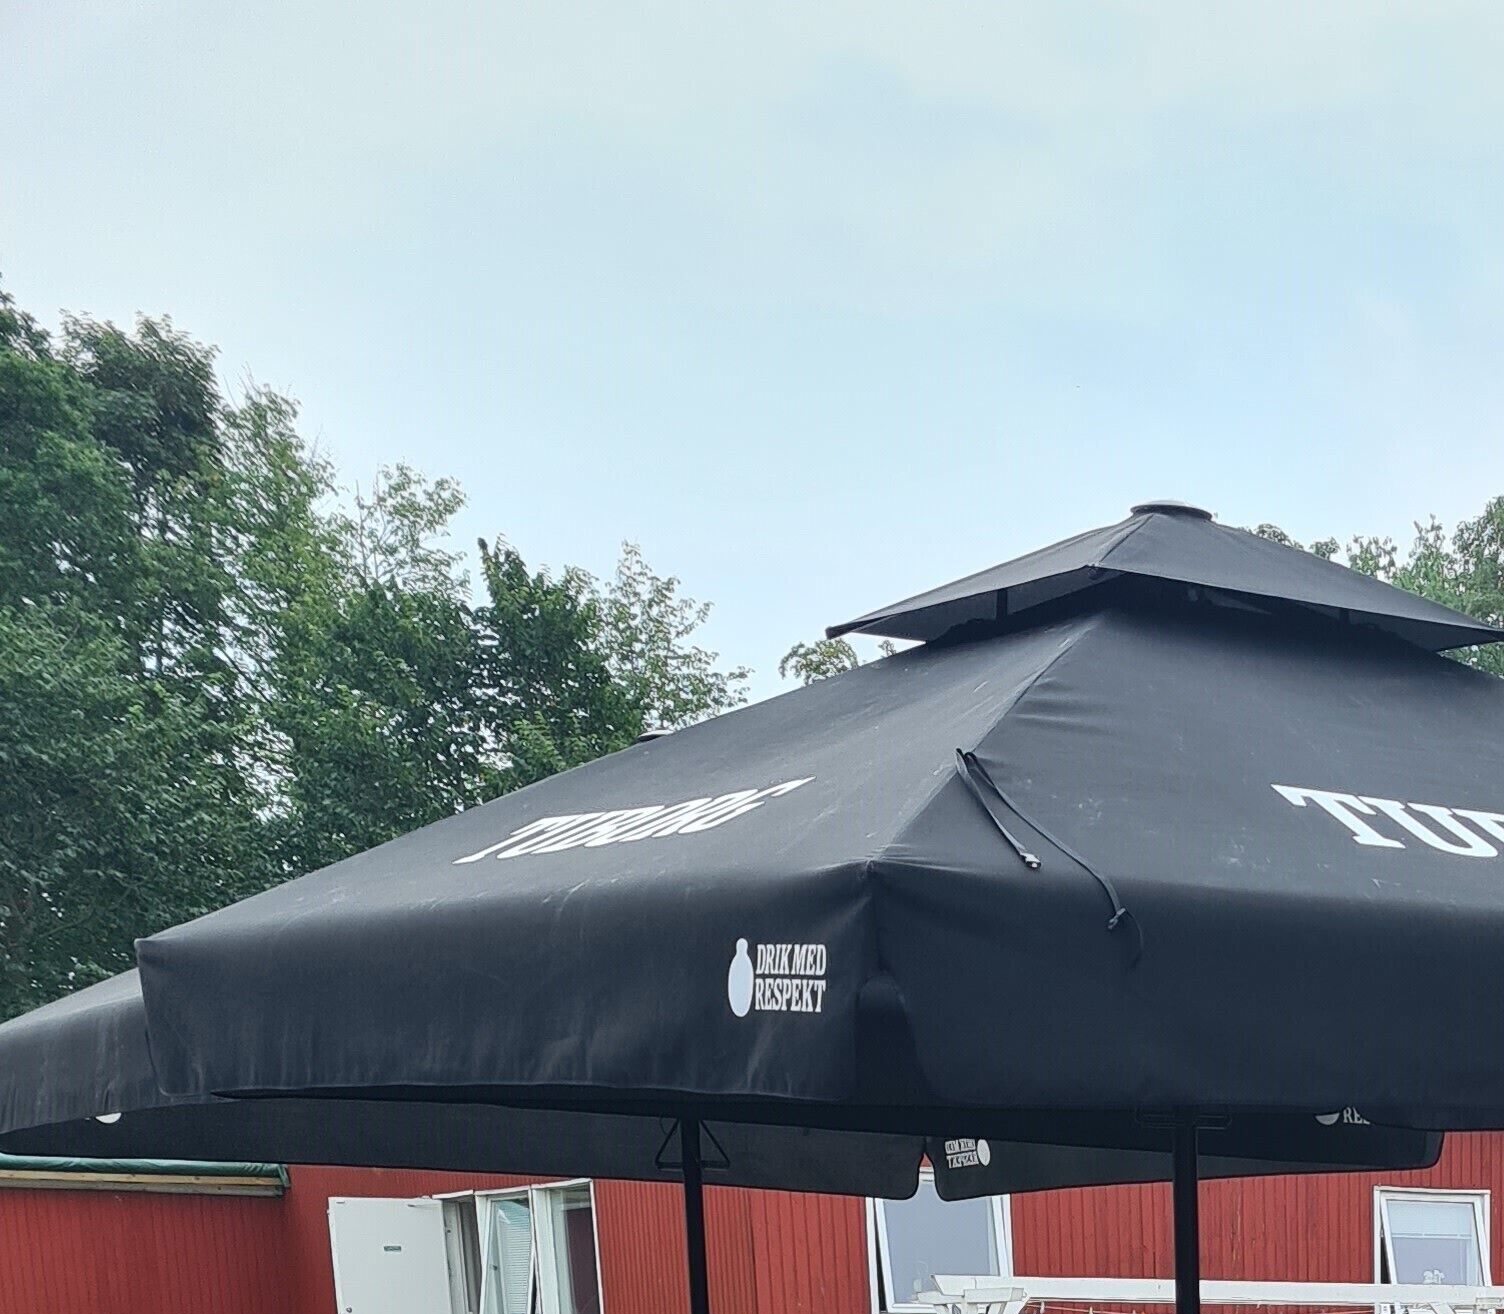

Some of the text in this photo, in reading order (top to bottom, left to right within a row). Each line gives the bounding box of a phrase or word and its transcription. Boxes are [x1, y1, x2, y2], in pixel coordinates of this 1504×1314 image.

[755, 944, 827, 976] DRIK MED
[755, 978, 827, 1013] RESPEKT
